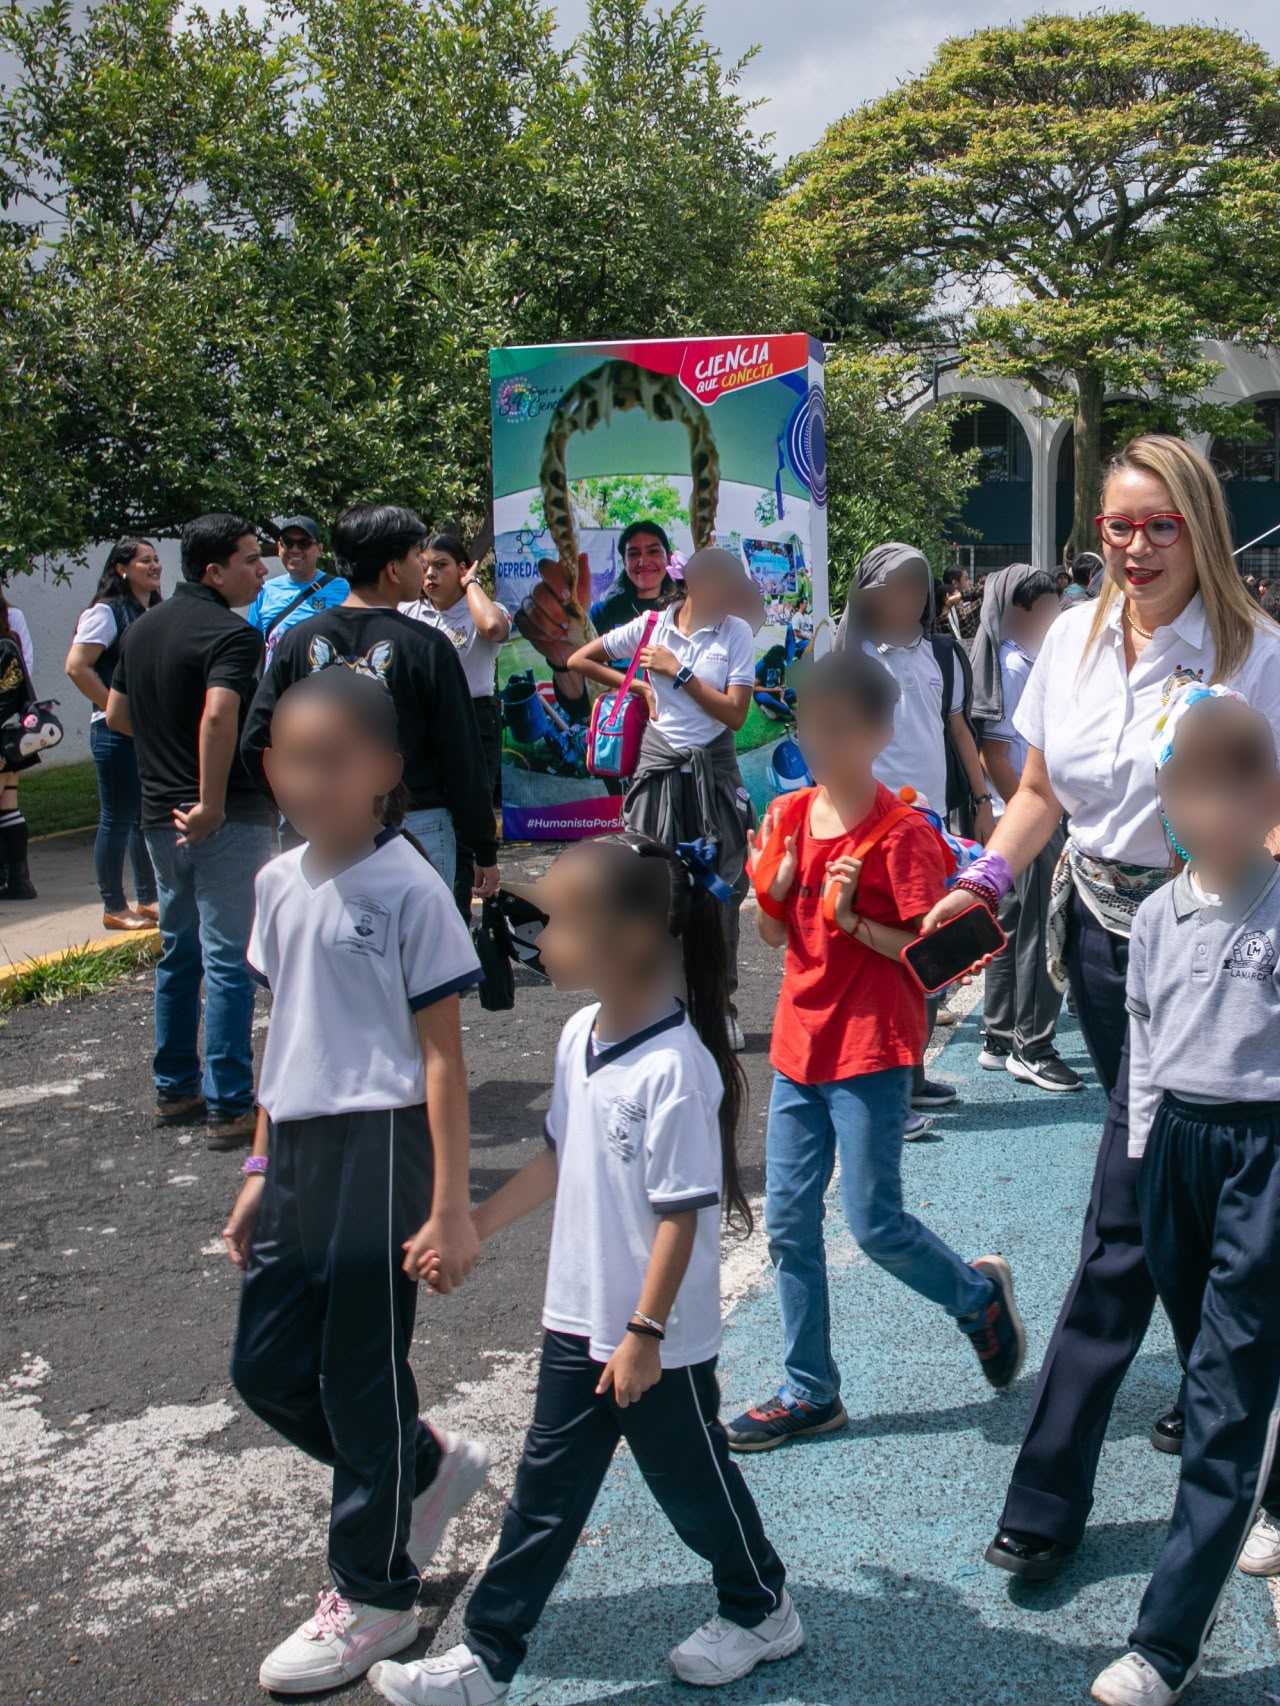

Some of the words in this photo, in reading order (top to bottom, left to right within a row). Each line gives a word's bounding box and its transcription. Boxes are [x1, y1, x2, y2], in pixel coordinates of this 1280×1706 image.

[695, 342, 769, 379] CIENCIA
[697, 378, 719, 393] QUE
[721, 363, 774, 387] CONECTA
[497, 561, 539, 578] DEPREDA
